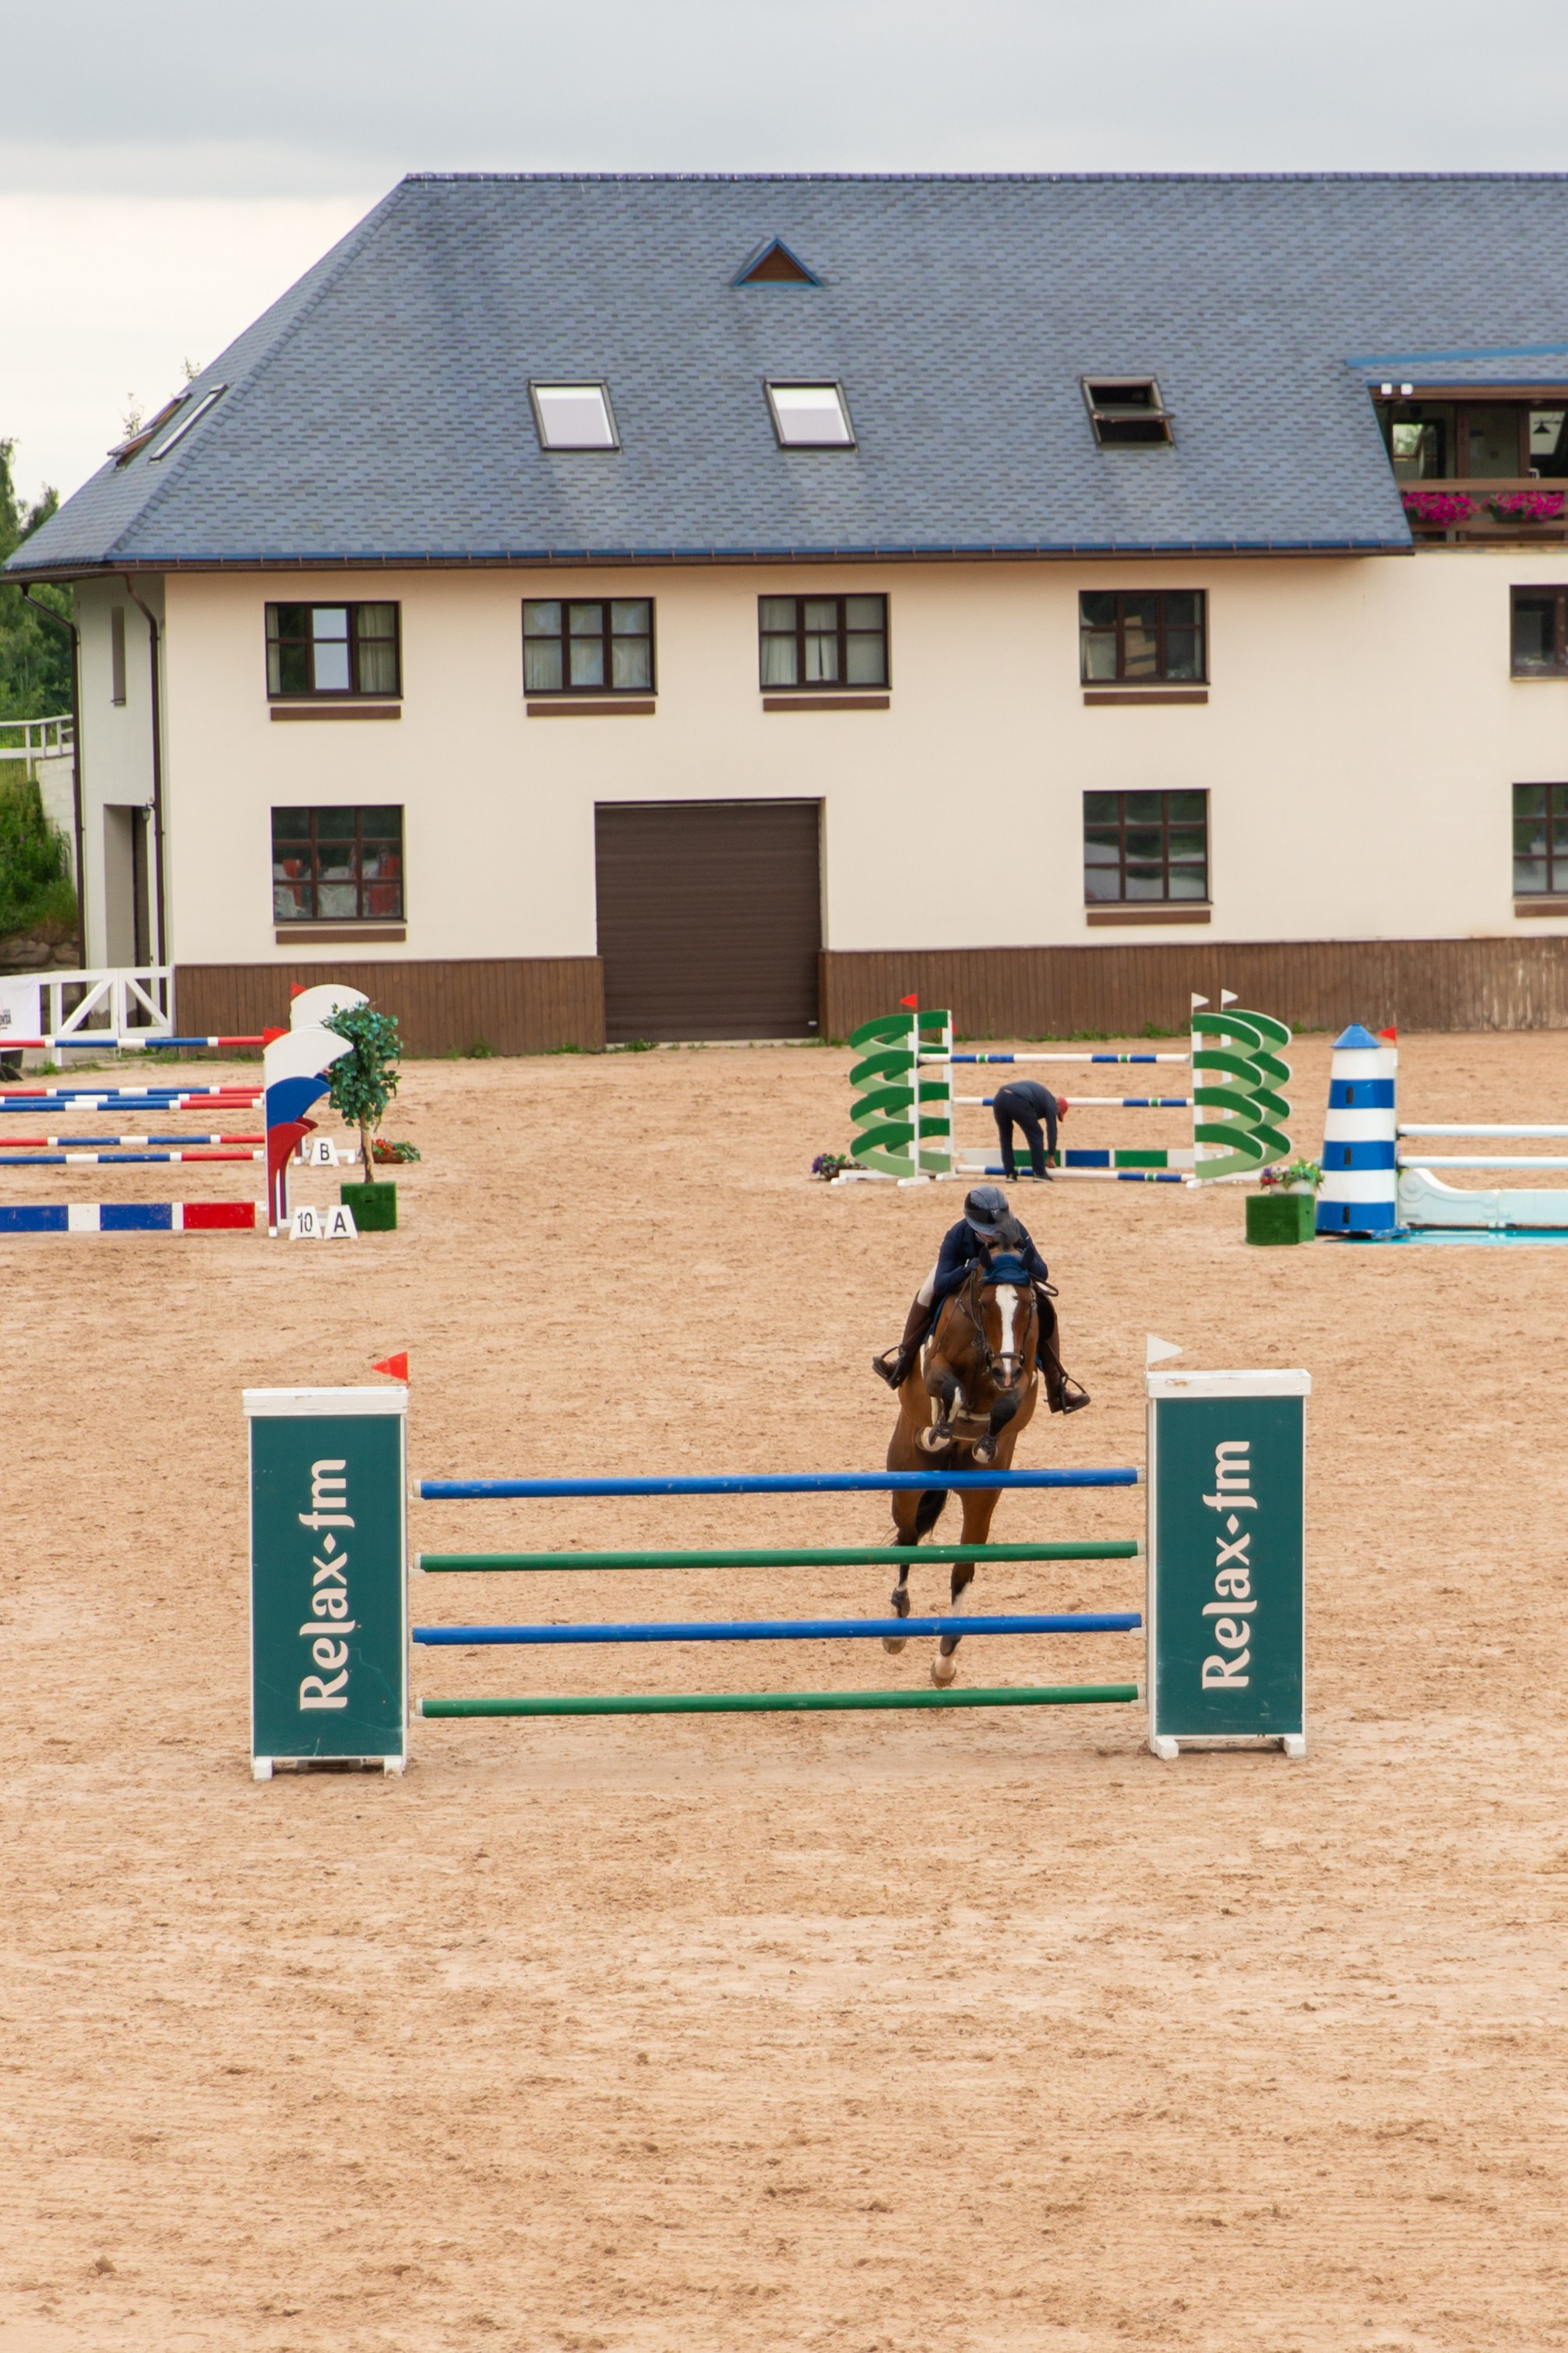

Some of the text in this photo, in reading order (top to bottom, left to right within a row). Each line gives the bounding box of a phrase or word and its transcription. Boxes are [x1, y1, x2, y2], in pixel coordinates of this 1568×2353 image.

[320, 1143, 329, 1160] B
[298, 1212, 312, 1233] 10
[334, 1212, 347, 1233] A
